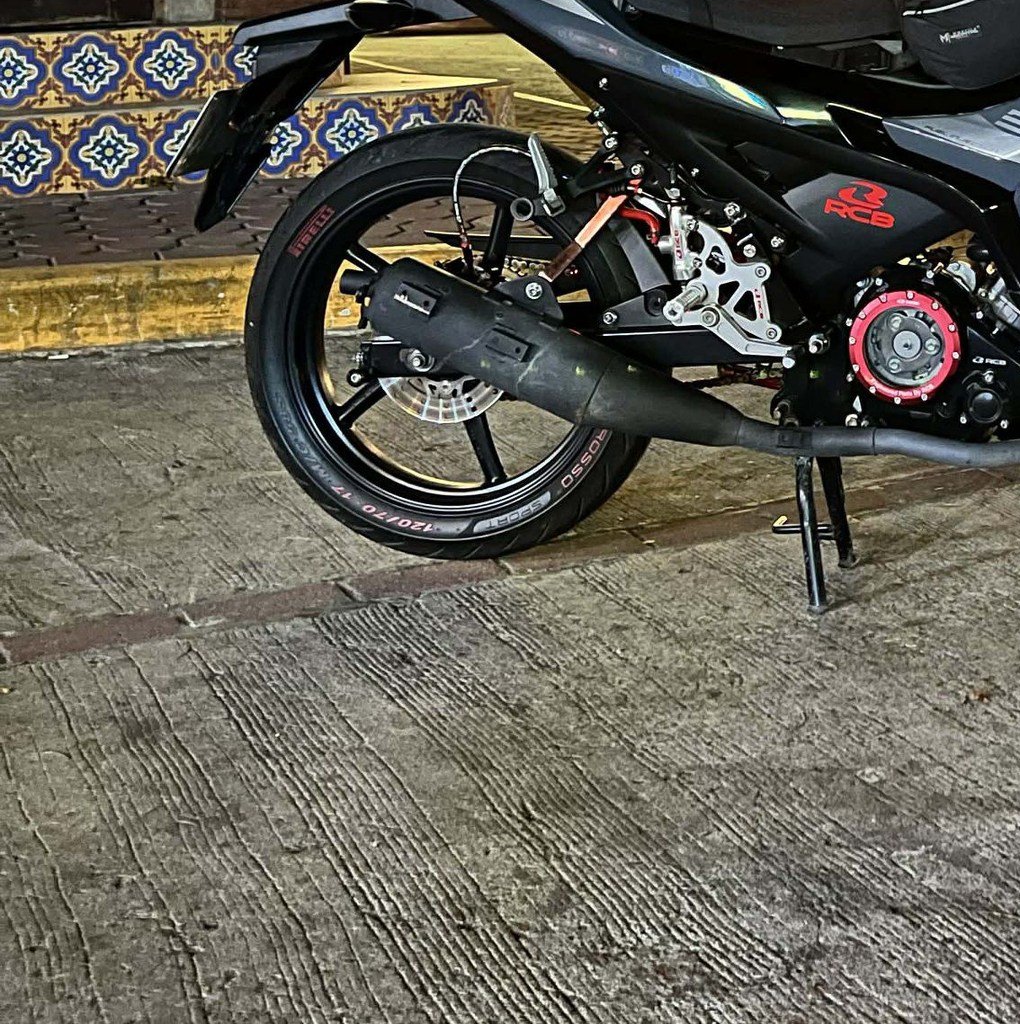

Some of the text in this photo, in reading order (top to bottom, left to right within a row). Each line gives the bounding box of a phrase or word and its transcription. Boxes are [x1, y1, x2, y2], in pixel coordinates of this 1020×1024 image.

[824, 198, 896, 229] RCB
[287, 205, 335, 257] PIRELLI
[561, 429, 607, 488] ROSSO
[361, 504, 434, 532] 120/70
[487, 500, 542, 530] SPORT
